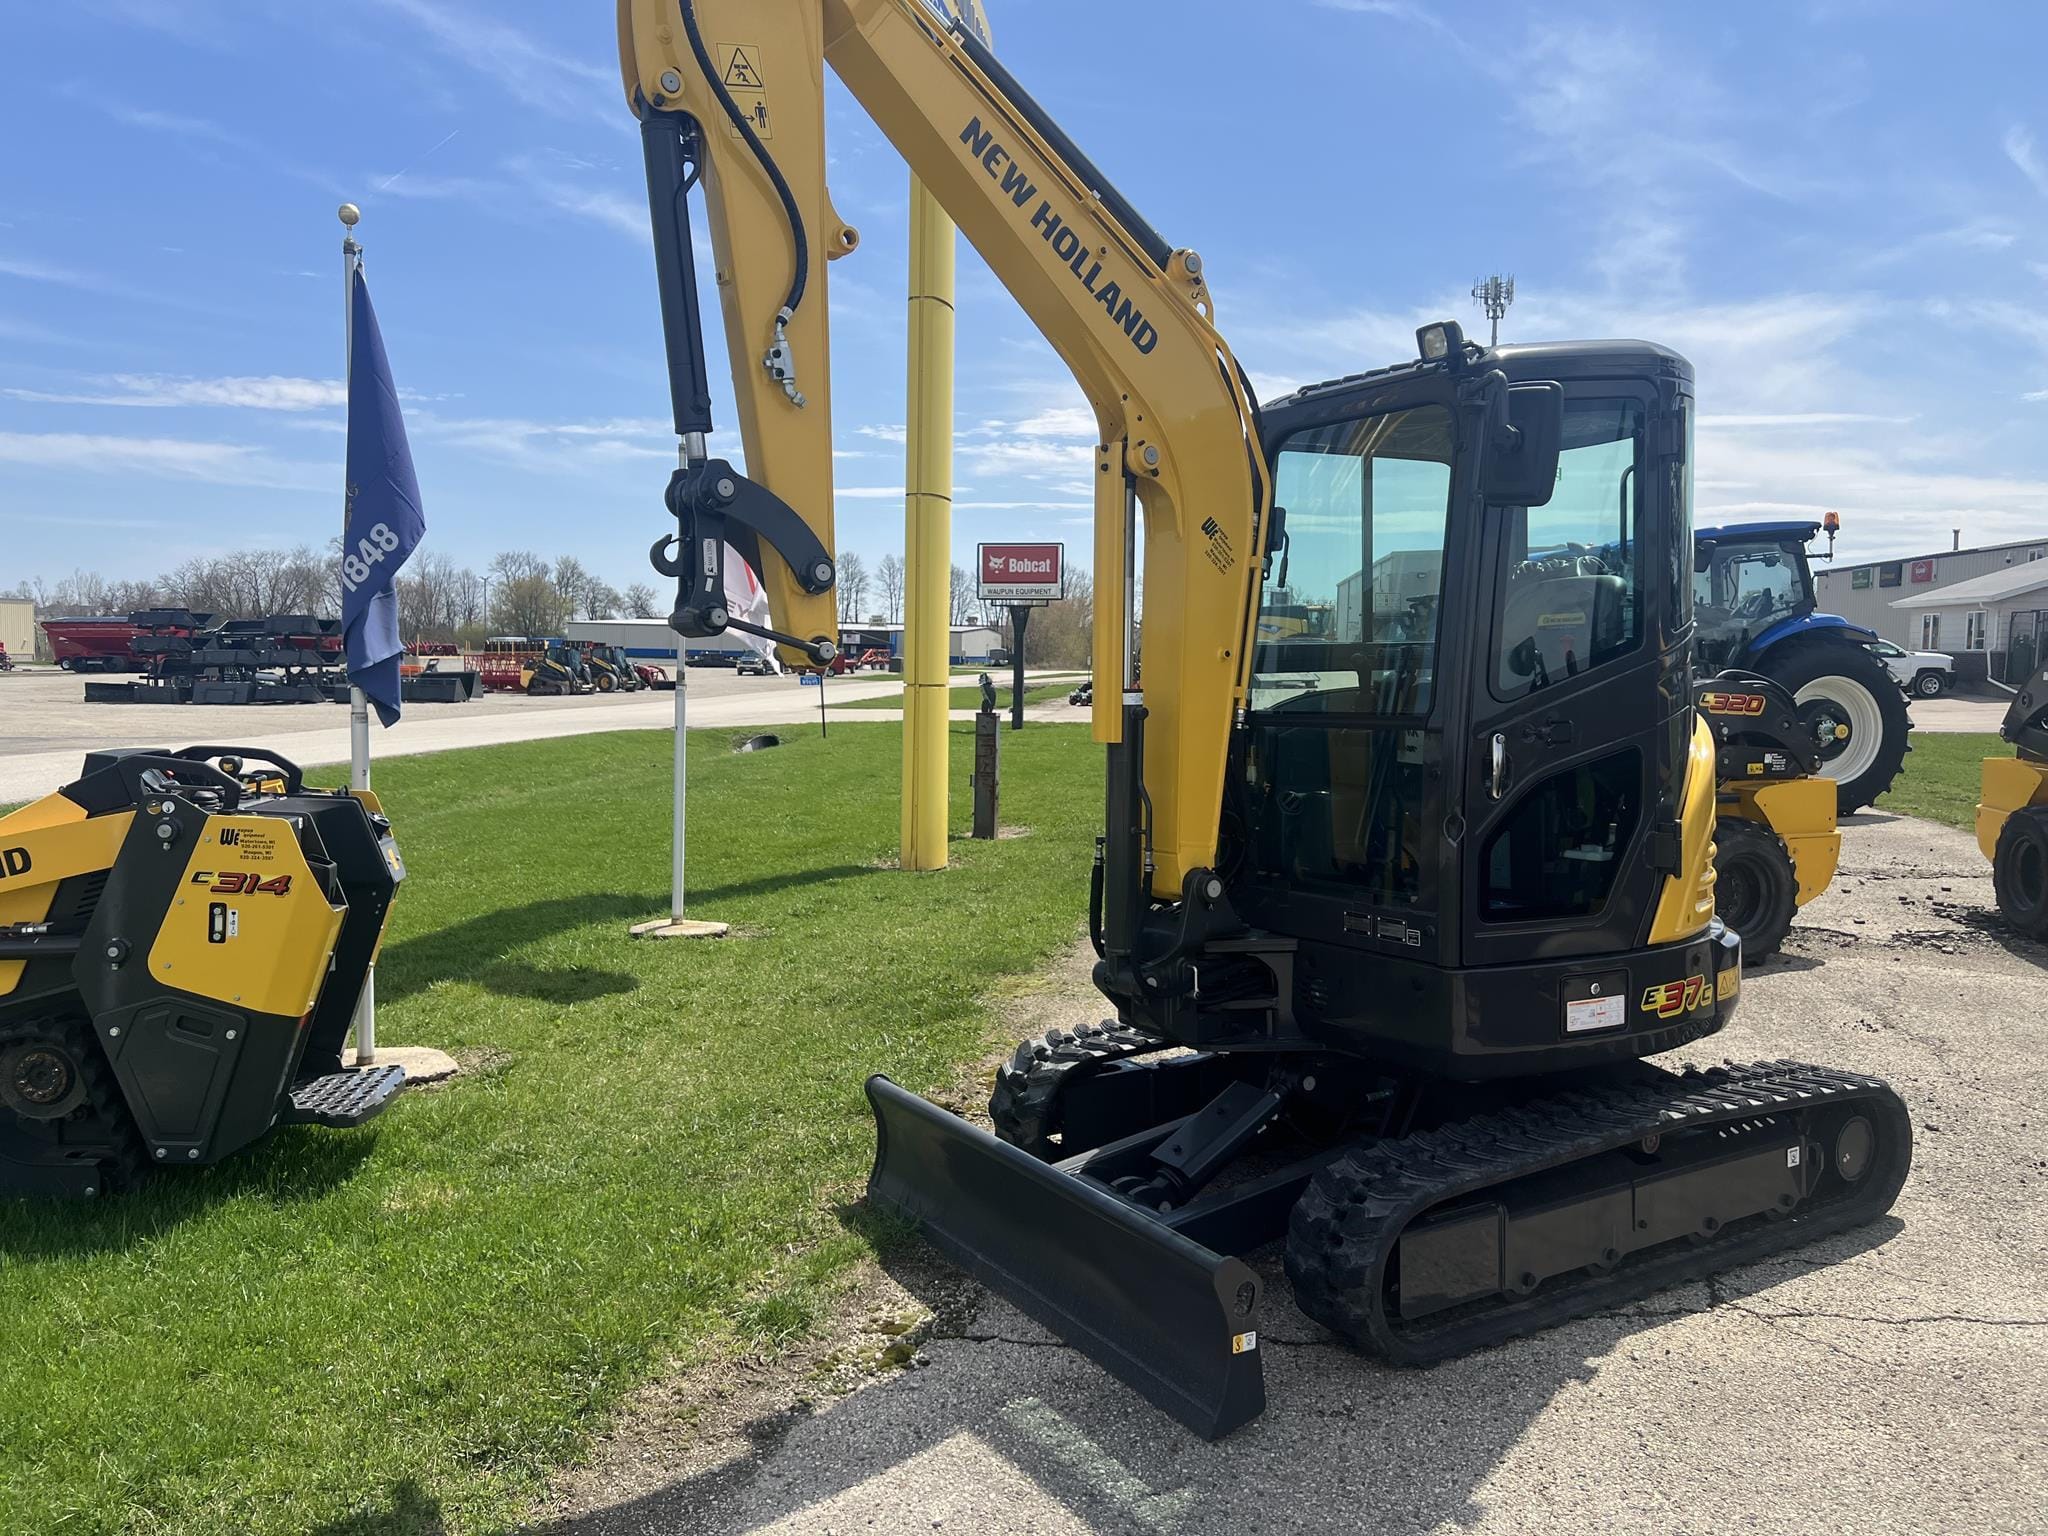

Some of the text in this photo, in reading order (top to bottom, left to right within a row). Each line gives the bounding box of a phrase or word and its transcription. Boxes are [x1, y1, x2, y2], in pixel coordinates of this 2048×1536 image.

[959, 116, 1158, 355] NEW HOLLAND
[342, 523, 399, 592] 1848
[1009, 558, 1051, 573] Bobcat
[191, 871, 292, 896] C314
